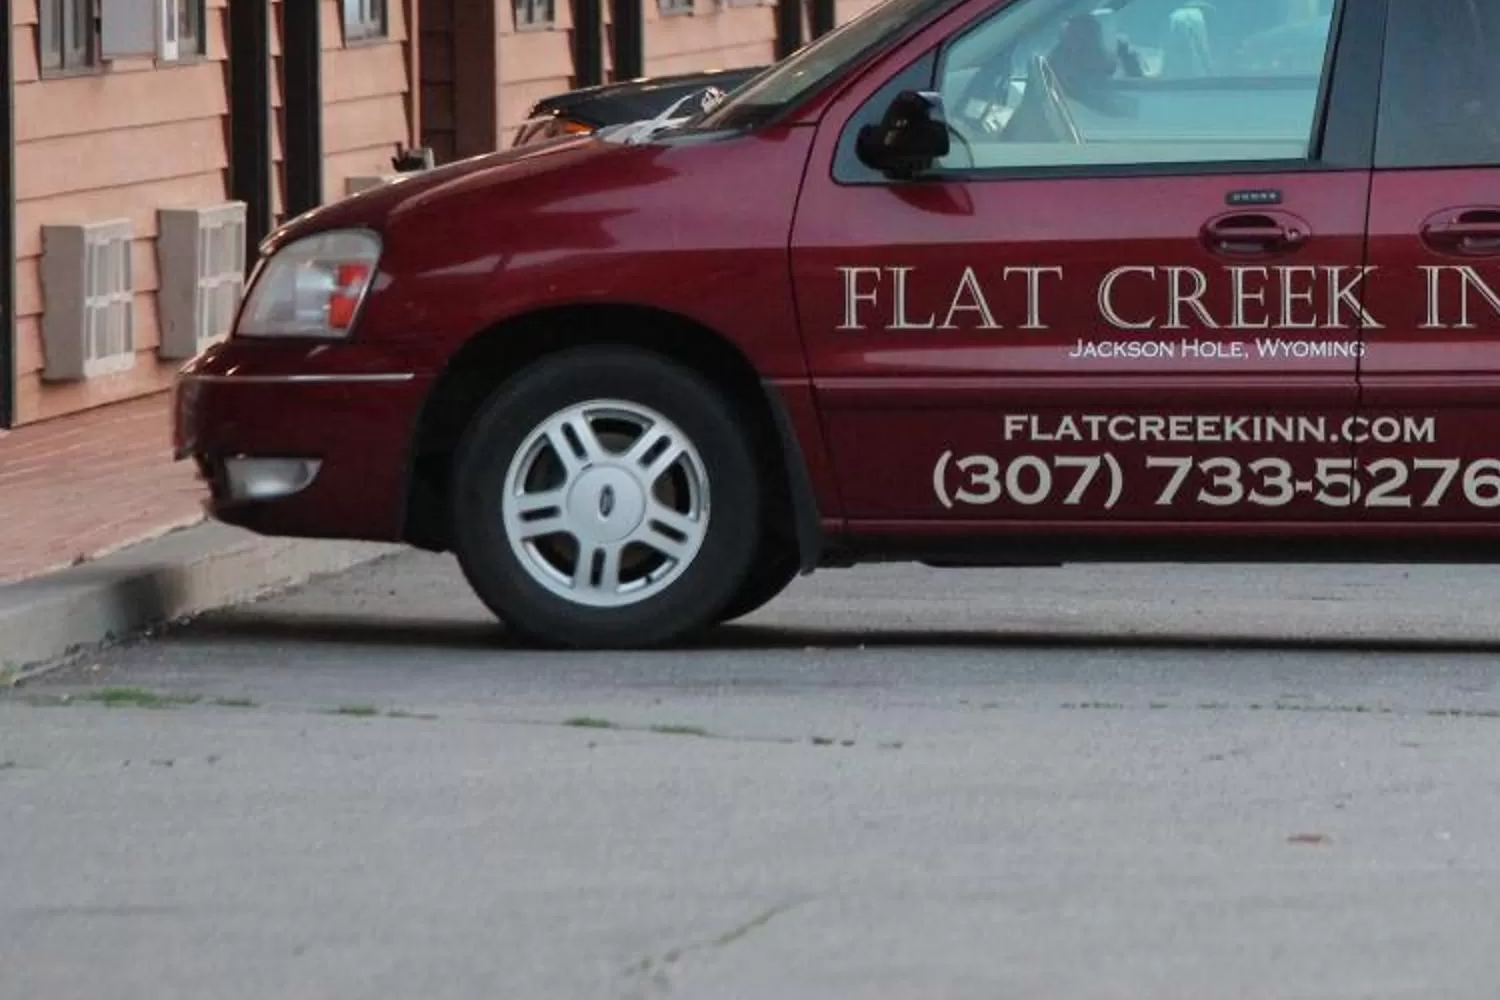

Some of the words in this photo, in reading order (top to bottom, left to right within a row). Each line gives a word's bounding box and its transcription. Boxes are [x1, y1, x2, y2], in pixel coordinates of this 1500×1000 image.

[837, 266, 1063, 329] FLAT
[1097, 266, 1384, 329] CREEK
[1069, 339, 1175, 358] JACKSON
[1181, 339, 1249, 359] HOLE,
[1255, 338, 1366, 358] WYOMING
[1003, 415, 1436, 443] FLATCREEKINN.COM
[933, 450, 1123, 508] (307)
